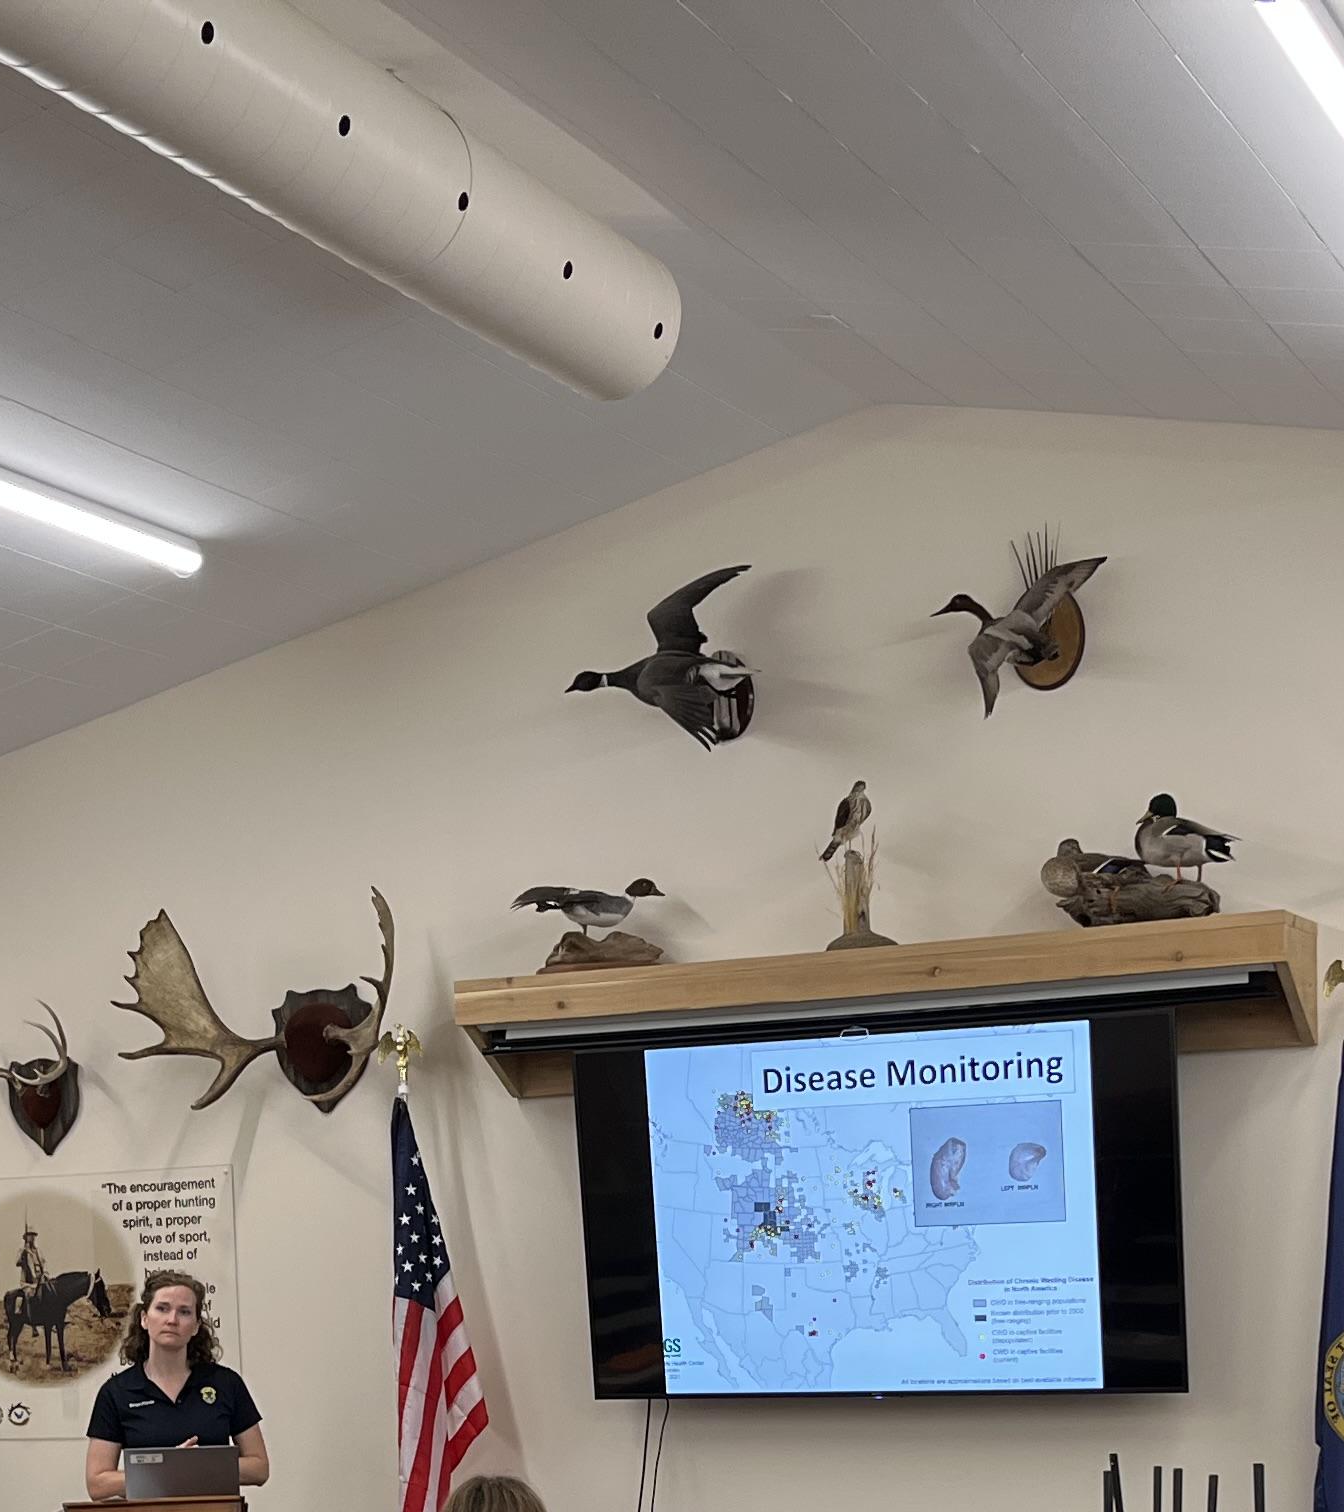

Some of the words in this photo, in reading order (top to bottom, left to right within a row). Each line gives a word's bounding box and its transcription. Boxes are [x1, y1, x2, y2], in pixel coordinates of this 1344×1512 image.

[761, 1066, 876, 1096] Disease
[886, 1051, 1064, 1087] Monitoring
[130, 1177, 215, 1193] encouragement
[112, 1200, 122, 1211] of
[126, 1201, 133, 1211] a
[136, 1200, 172, 1213] proper
[175, 1196, 215, 1209] hunting
[122, 1216, 152, 1230] spirit,
[156, 1217, 163, 1227] a
[166, 1215, 202, 1228] proper
[139, 1233, 162, 1244] love
[165, 1232, 175, 1243] of
[178, 1230, 211, 1245] sport,
[144, 1249, 183, 1261] instead
[186, 1248, 197, 1260] of
